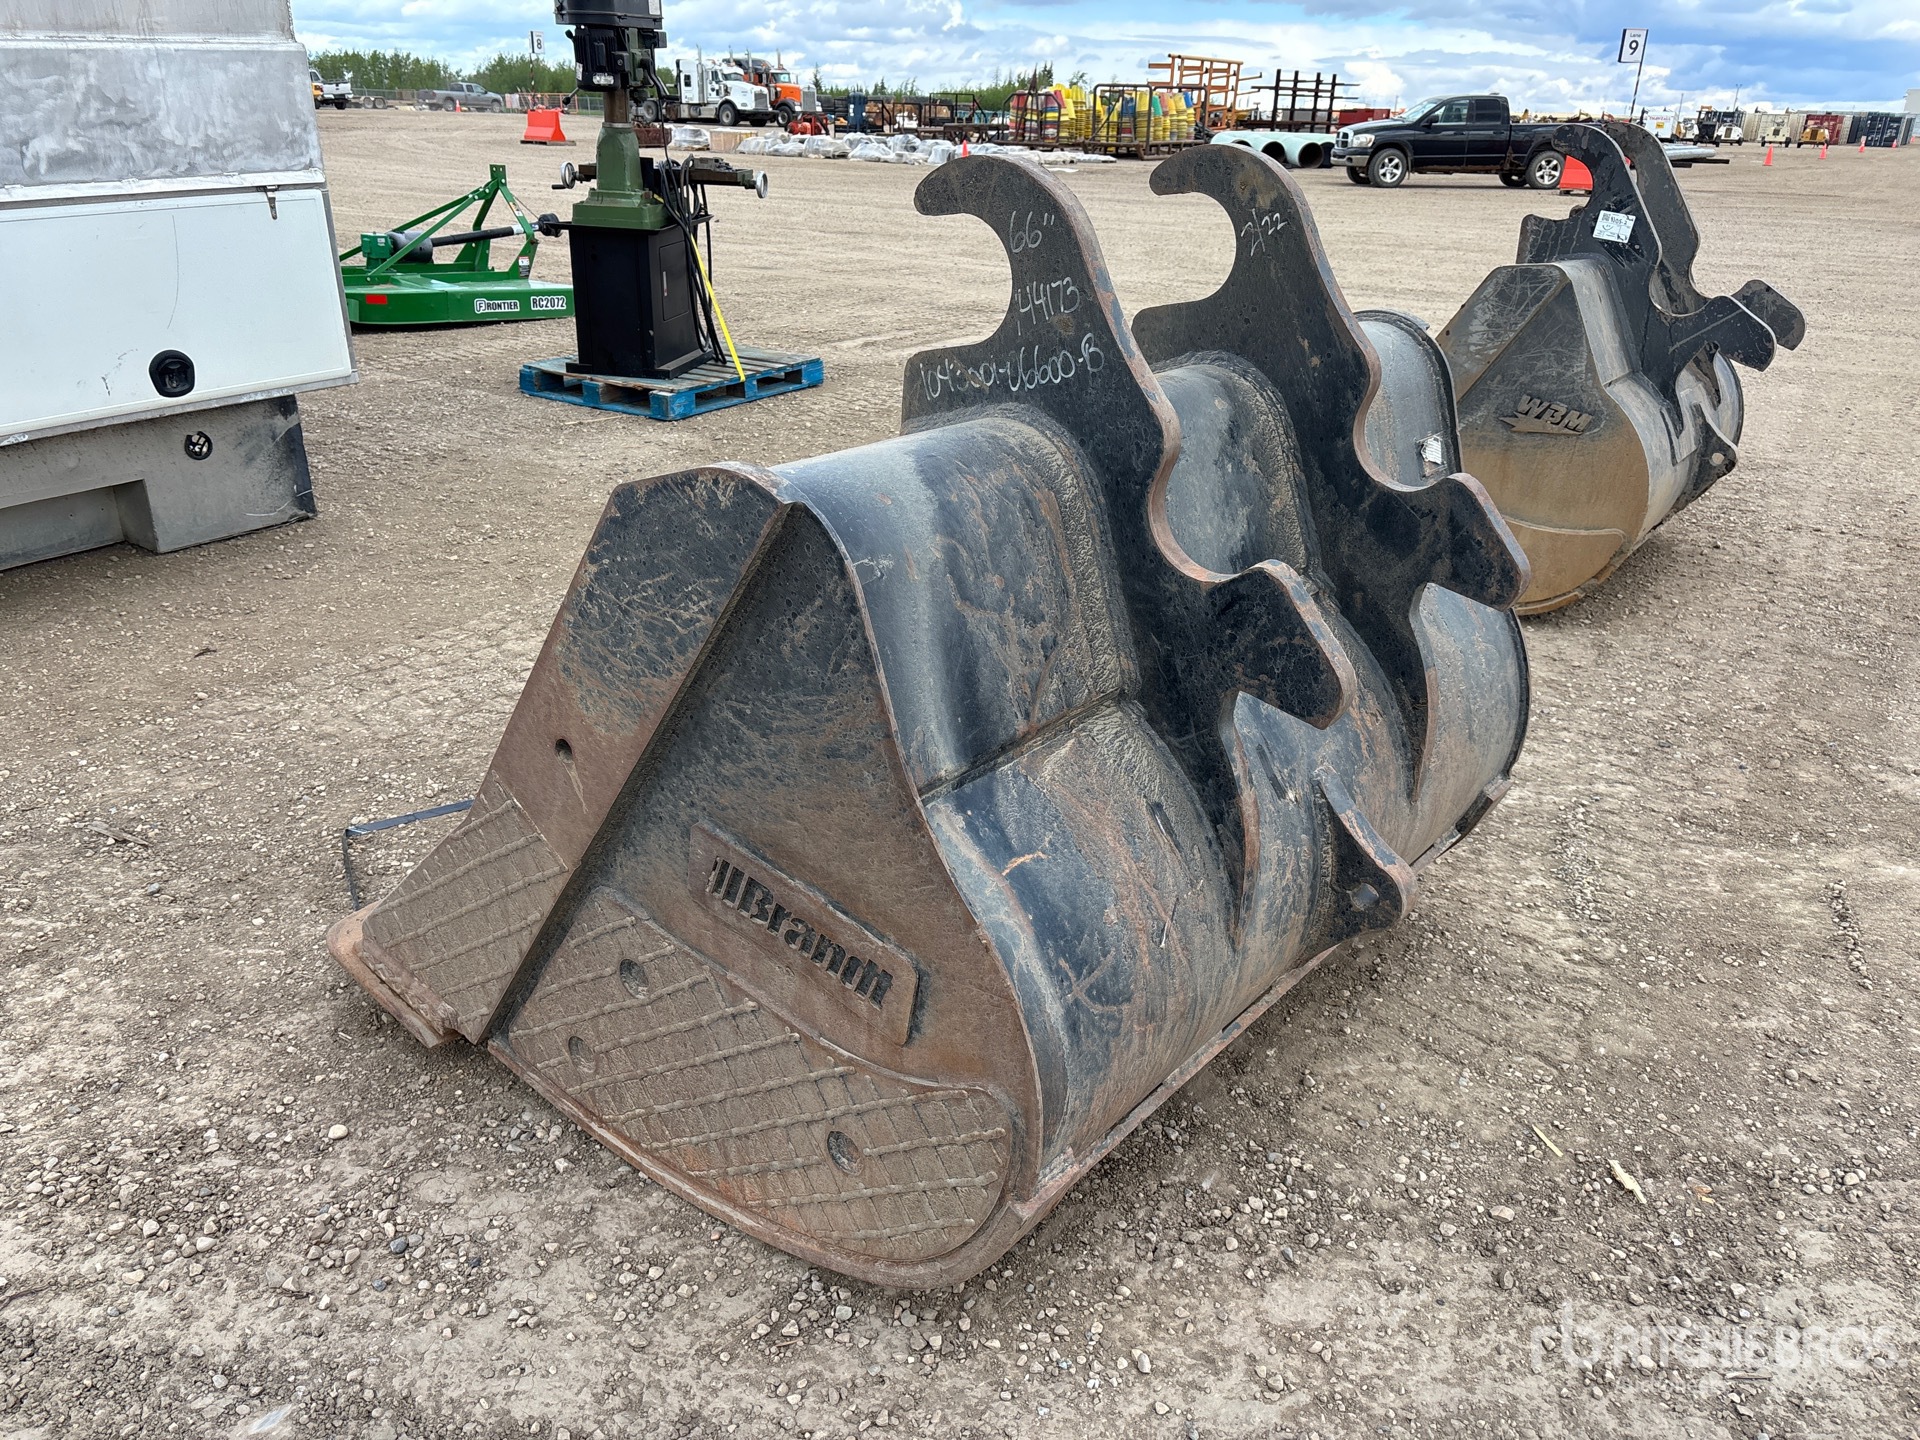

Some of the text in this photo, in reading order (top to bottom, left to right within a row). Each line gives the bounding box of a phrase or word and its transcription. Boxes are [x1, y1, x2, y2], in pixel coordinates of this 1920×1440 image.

[536, 38, 543, 50] 8
[1628, 39, 1640, 56] 9
[531, 296, 567, 310] RC2072
[1517, 393, 1594, 433] WBM
[736, 874, 894, 1010] Brandt
